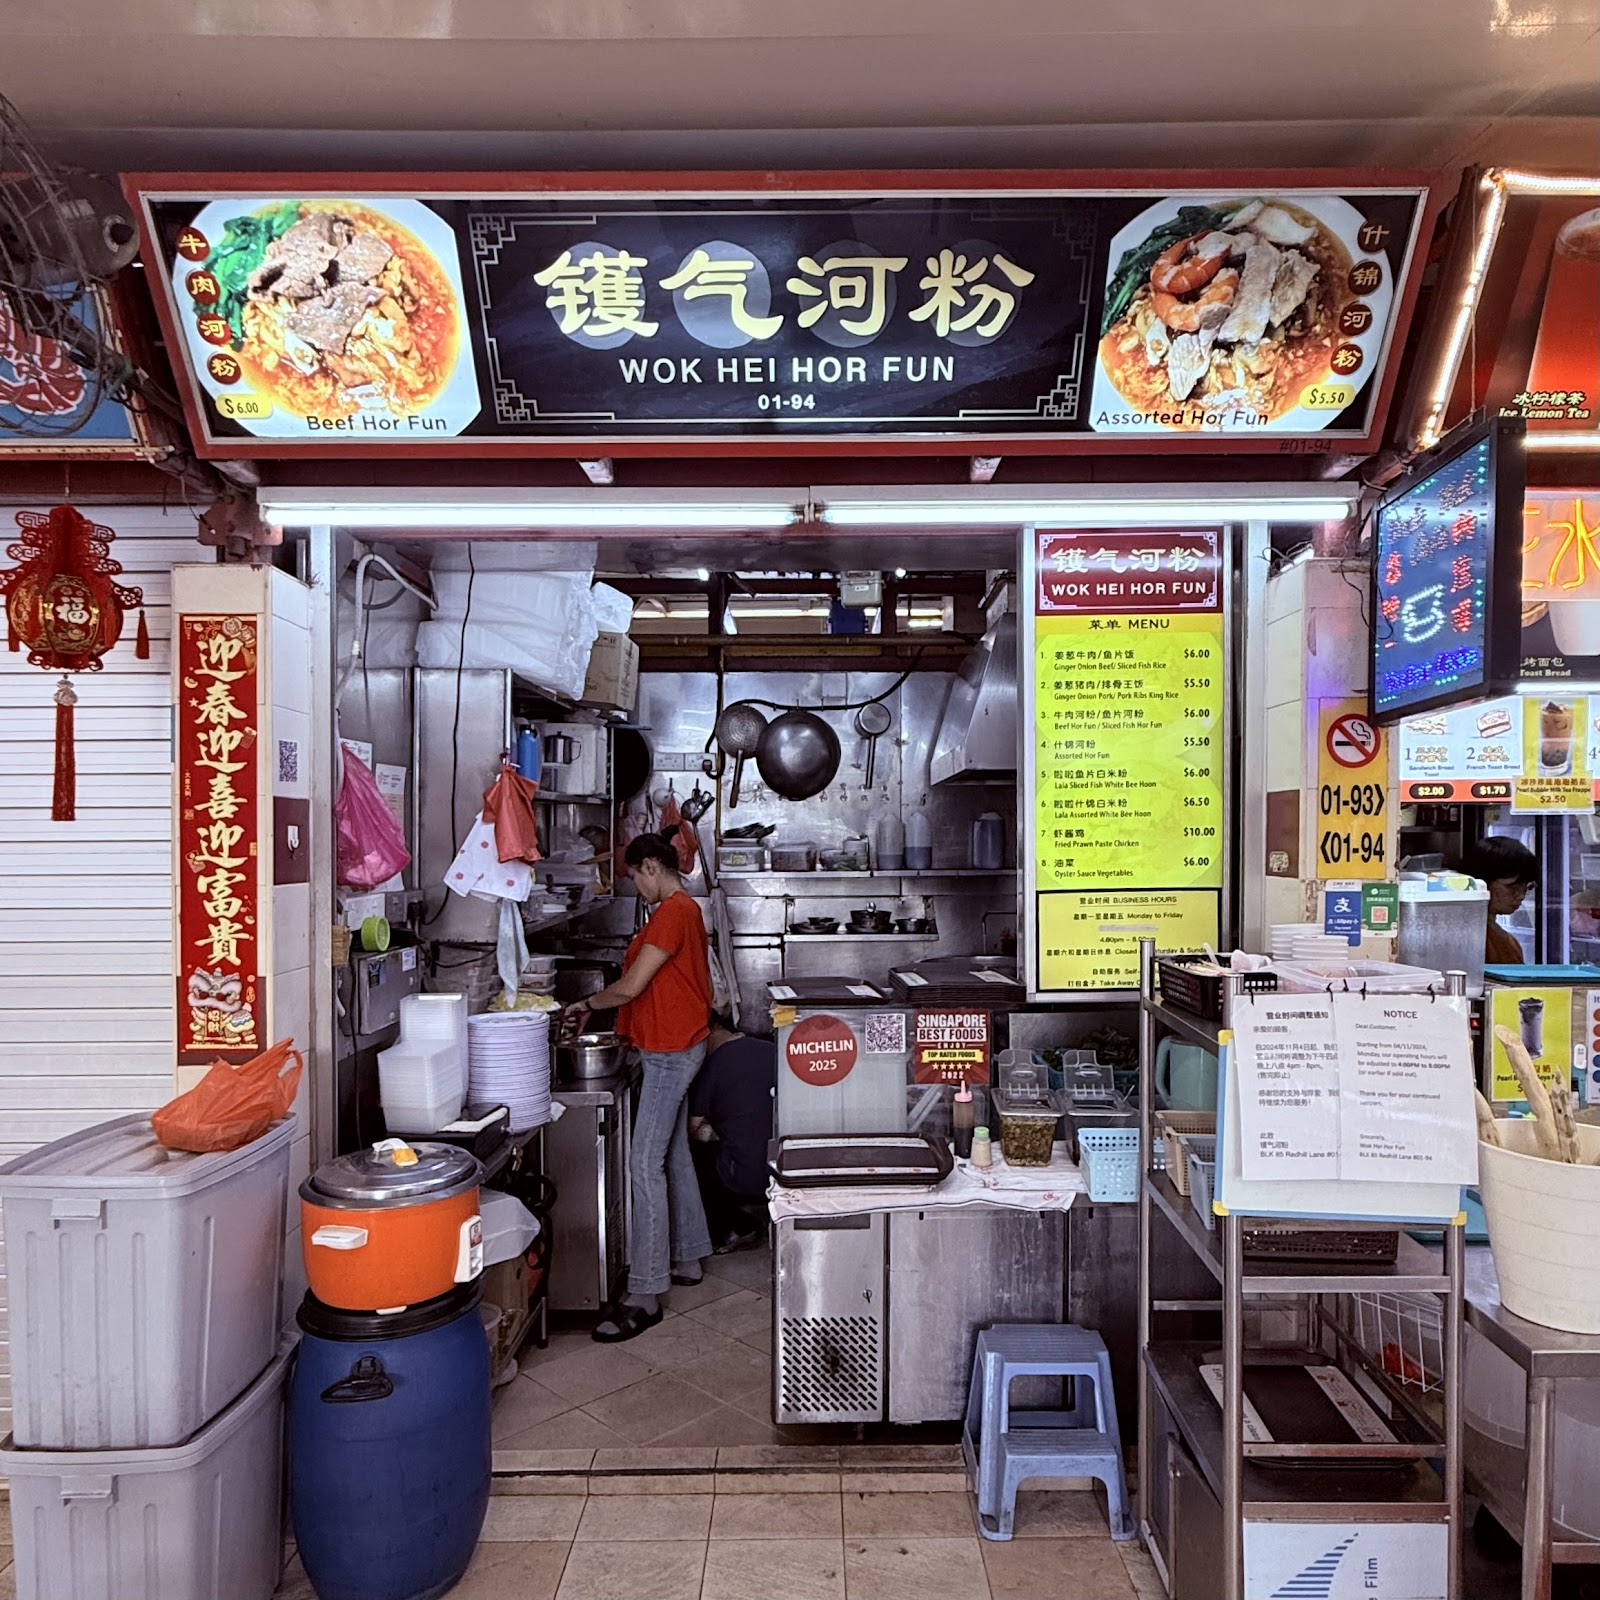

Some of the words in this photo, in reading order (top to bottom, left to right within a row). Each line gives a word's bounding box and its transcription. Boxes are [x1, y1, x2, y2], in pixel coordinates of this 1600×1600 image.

[533, 248, 1035, 339] 镬气河粉
[1333, 225, 1390, 367] 什锦河粉
[179, 234, 237, 377] 牛肉河粉
[618, 358, 703, 383] WOK
[718, 357, 776, 382] HEI
[792, 356, 866, 382] HOR
[884, 355, 954, 381] FUN
[758, 394, 815, 410] 01-94
[1309, 388, 1345, 404] $5.50
[1512, 391, 1585, 405] 冰柠檬茶
[1097, 410, 1187, 427] Assorted
[1191, 410, 1225, 427] Hor
[1233, 410, 1269, 427] Fun
[1499, 407, 1518, 417] Ice
[1521, 407, 1563, 418] Lemon
[1567, 407, 1589, 418] Tea
[307, 415, 355, 432] Beef
[363, 415, 400, 432] Hor
[408, 414, 447, 431] Fun
[1280, 439, 1332, 452] #01-94
[1051, 547, 1205, 574] 镬气河粉
[1051, 584, 1090, 596] WOK
[1096, 583, 1124, 595] HEI
[1130, 582, 1166, 595] HOR
[1172, 582, 1206, 594] FUN
[1088, 619, 1121, 629] 菜单
[1128, 619, 1169, 629] MENU
[1184, 649, 1210, 658] $6.00
[1054, 663, 1076, 672] Ginger
[1077, 663, 1097, 671] Onion
[1117, 662, 1137, 670] Sliced
[1184, 679, 1210, 688] $5.50
[1054, 693, 1076, 702] Ginger
[1148, 692, 1164, 701] King
[1165, 691, 1179, 699] Rice
[1184, 708, 1210, 718] $6.00
[1054, 740, 1096, 749] 什锦河粉
[1184, 737, 1210, 747] $5.50
[1405, 748, 1412, 760] 1
[1466, 747, 1475, 759] 2
[1184, 768, 1210, 777] $6.00
[1418, 786, 1444, 796] $2.00
[1480, 785, 1506, 795] $1.70
[1184, 797, 1210, 806] $6.50
[1320, 785, 1374, 815] 01-93
[1540, 795, 1566, 803] $2.50
[1184, 827, 1215, 836] $10.00
[1331, 832, 1384, 862] 01-94
[1184, 857, 1209, 866] $6.00
[1055, 870, 1075, 879] Oyster
[1097, 870, 1133, 878] Vegetables
[917, 1014, 986, 1027] SINGAPORE
[1383, 1010, 1418, 1019] NOTICE
[920, 1029, 945, 1040] BEST
[949, 1029, 984, 1040] FOODS
[789, 1039, 854, 1056] MICHELIN
[809, 1059, 838, 1072] 2025
[941, 1071, 964, 1079] 2022
[1364, 1557, 1378, 1589] Film
